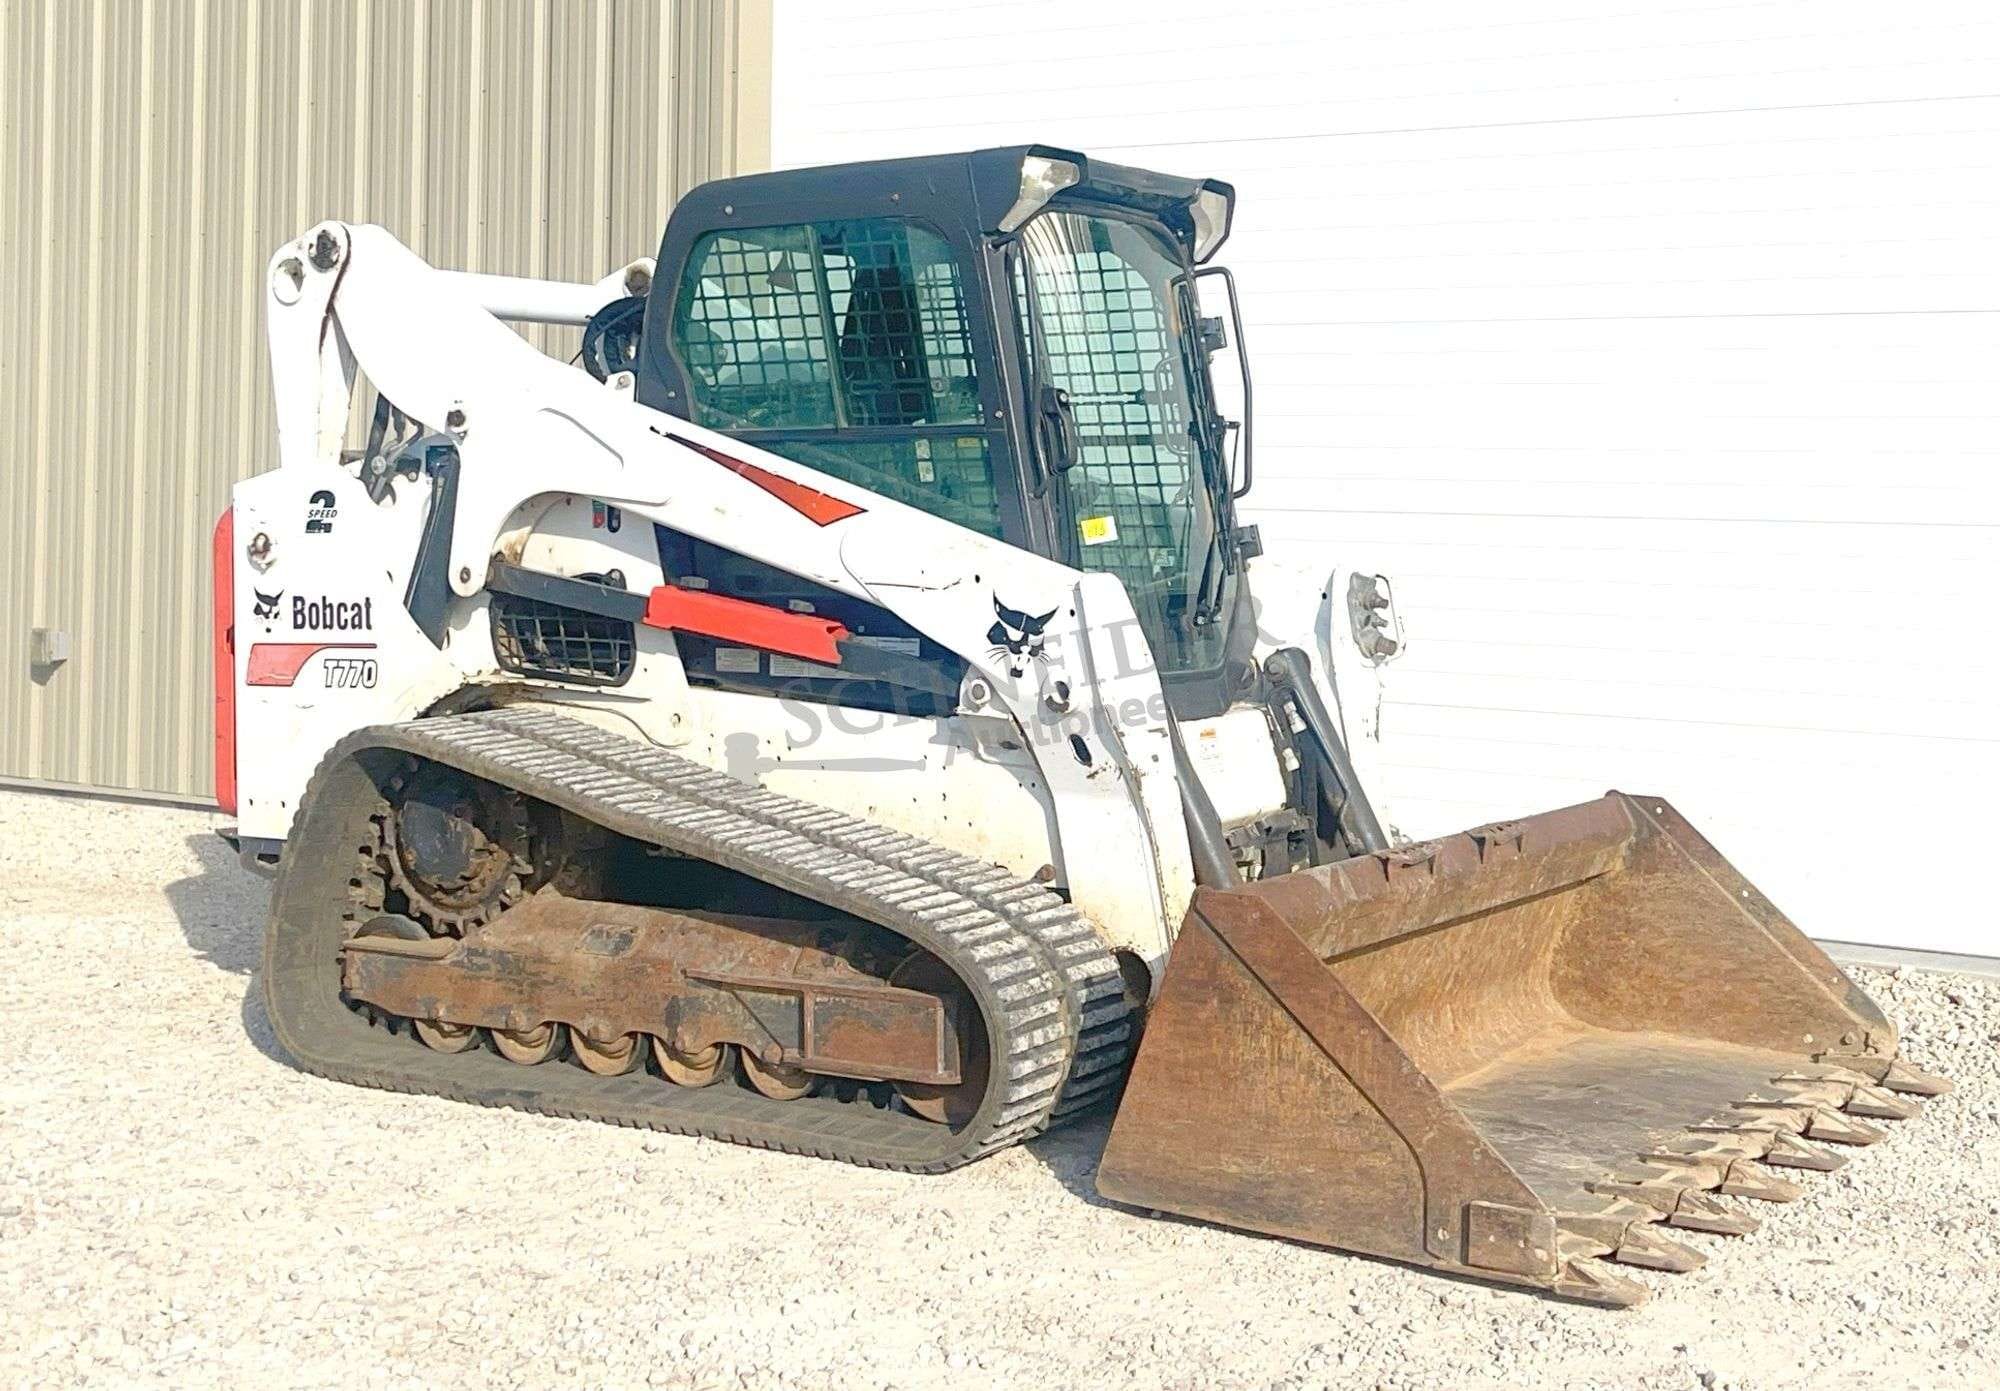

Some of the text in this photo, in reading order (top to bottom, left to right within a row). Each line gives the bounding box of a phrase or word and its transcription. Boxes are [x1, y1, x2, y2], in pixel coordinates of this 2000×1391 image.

[308, 509, 338, 518] SPEED
[292, 596, 372, 630] Bobcat
[323, 659, 378, 688] T770
